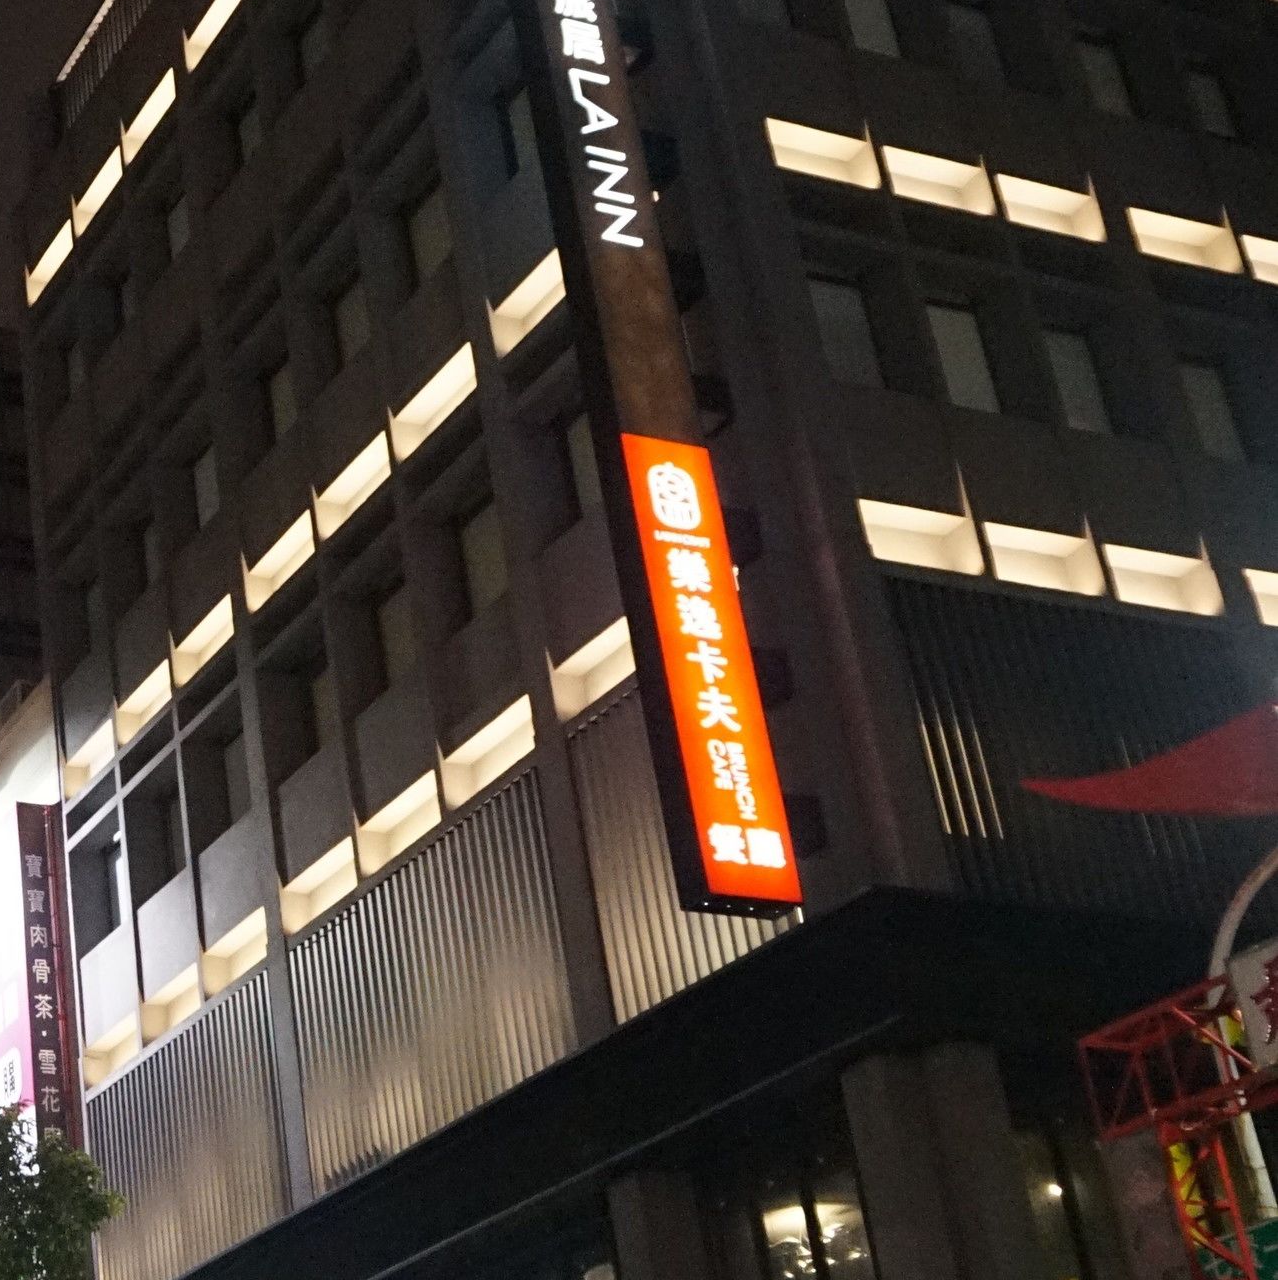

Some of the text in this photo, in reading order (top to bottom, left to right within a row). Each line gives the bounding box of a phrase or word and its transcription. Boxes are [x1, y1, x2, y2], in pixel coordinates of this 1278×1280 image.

[585, 145, 644, 248] INN
[666, 547, 742, 733] 樂逸卡夫
